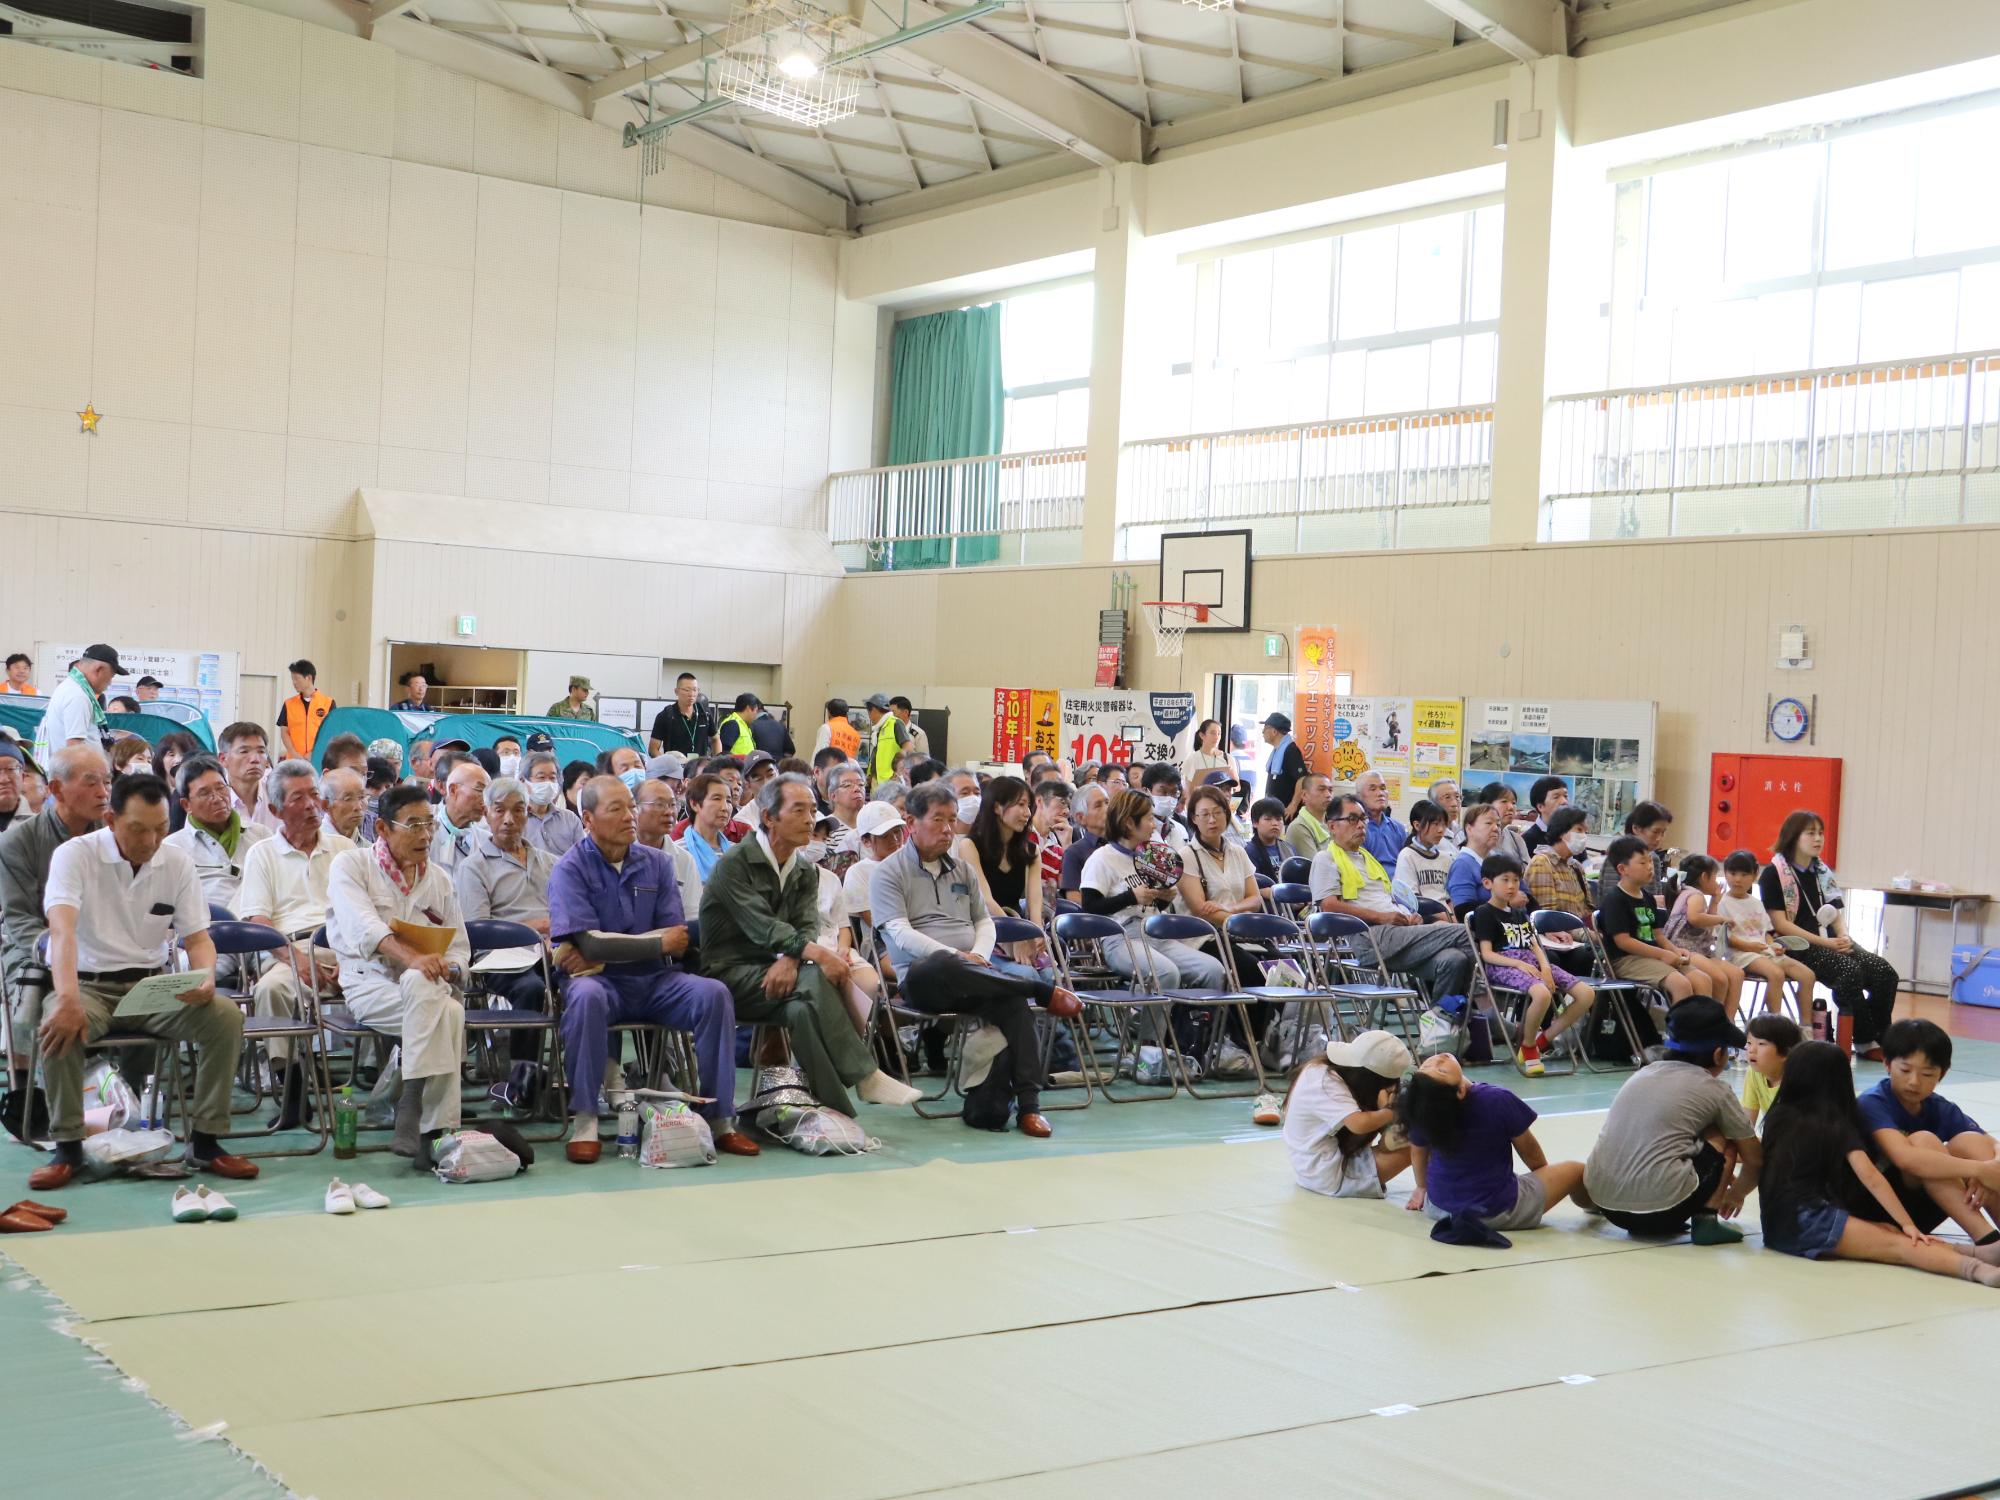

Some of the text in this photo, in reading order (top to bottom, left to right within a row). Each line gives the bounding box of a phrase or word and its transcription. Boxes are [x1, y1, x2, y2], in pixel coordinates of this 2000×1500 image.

[1303, 670, 1320, 775] フェニックス
